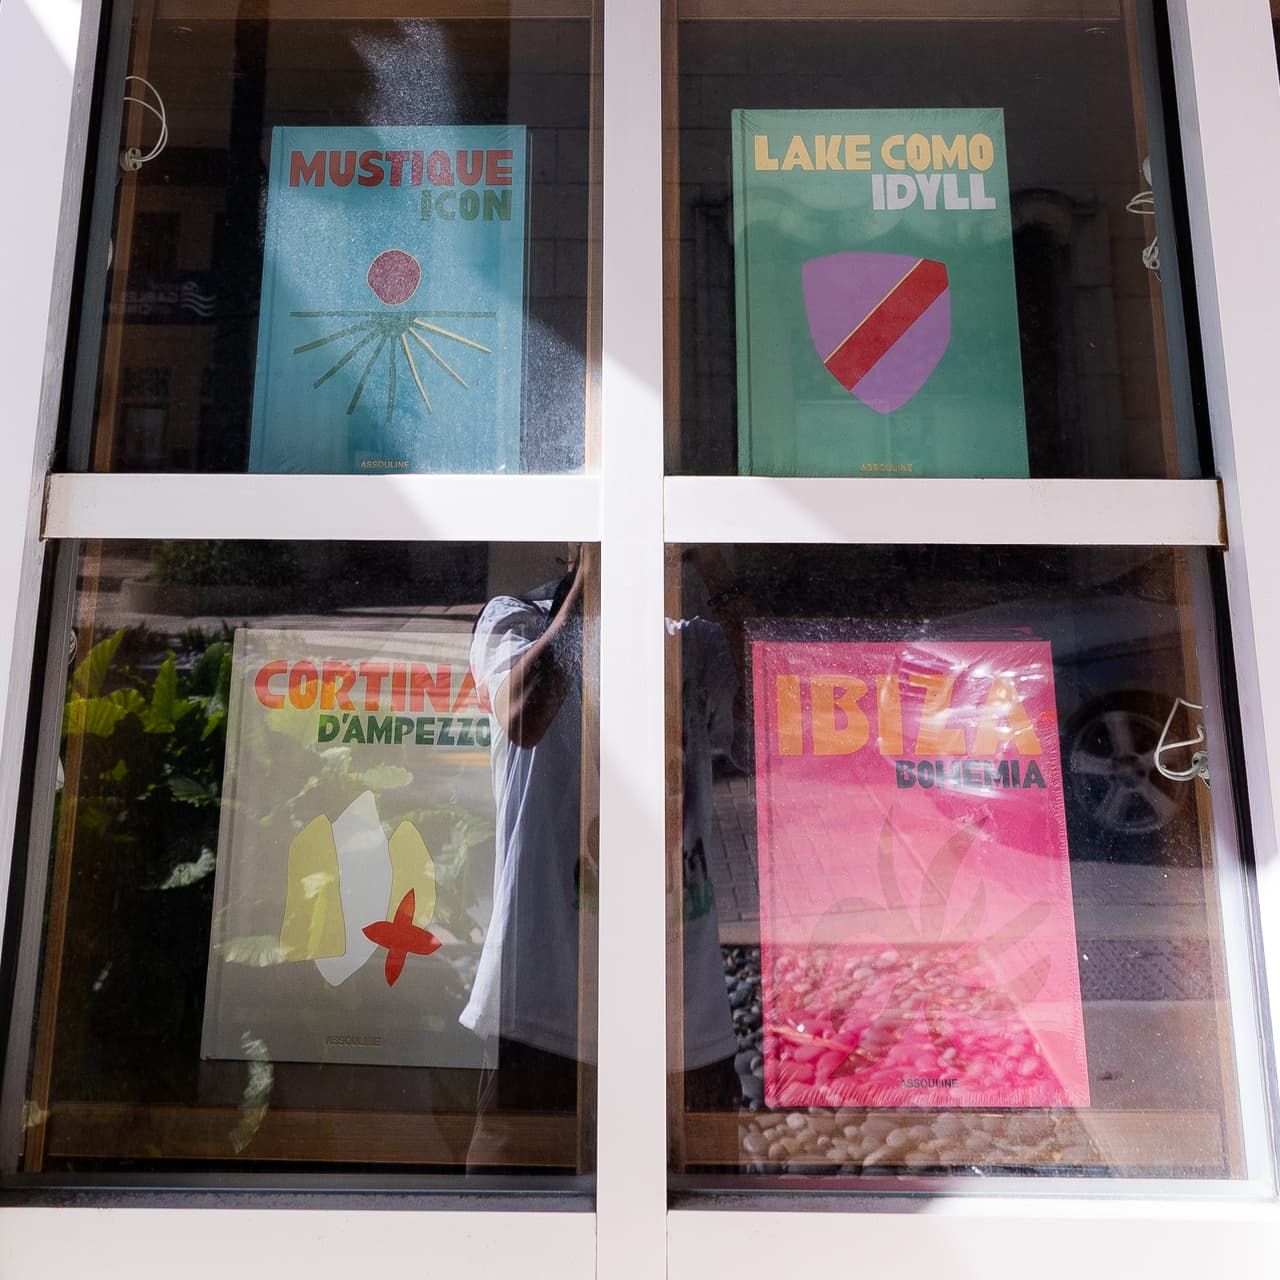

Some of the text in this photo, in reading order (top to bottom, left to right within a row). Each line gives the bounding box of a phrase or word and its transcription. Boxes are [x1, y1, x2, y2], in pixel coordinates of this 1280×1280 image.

[289, 149, 514, 188] MUSTIQUE
[753, 133, 994, 172] LAKE COMO
[420, 189, 512, 221] ICON
[871, 173, 996, 210] IDYLL
[255, 659, 493, 714] CORTINA
[317, 714, 492, 747] D'AMPEZZO
[776, 673, 1043, 756] IBIZA
[895, 759, 1047, 790] BOHEMIA
[901, 1078, 959, 1089] ASSOULINE
